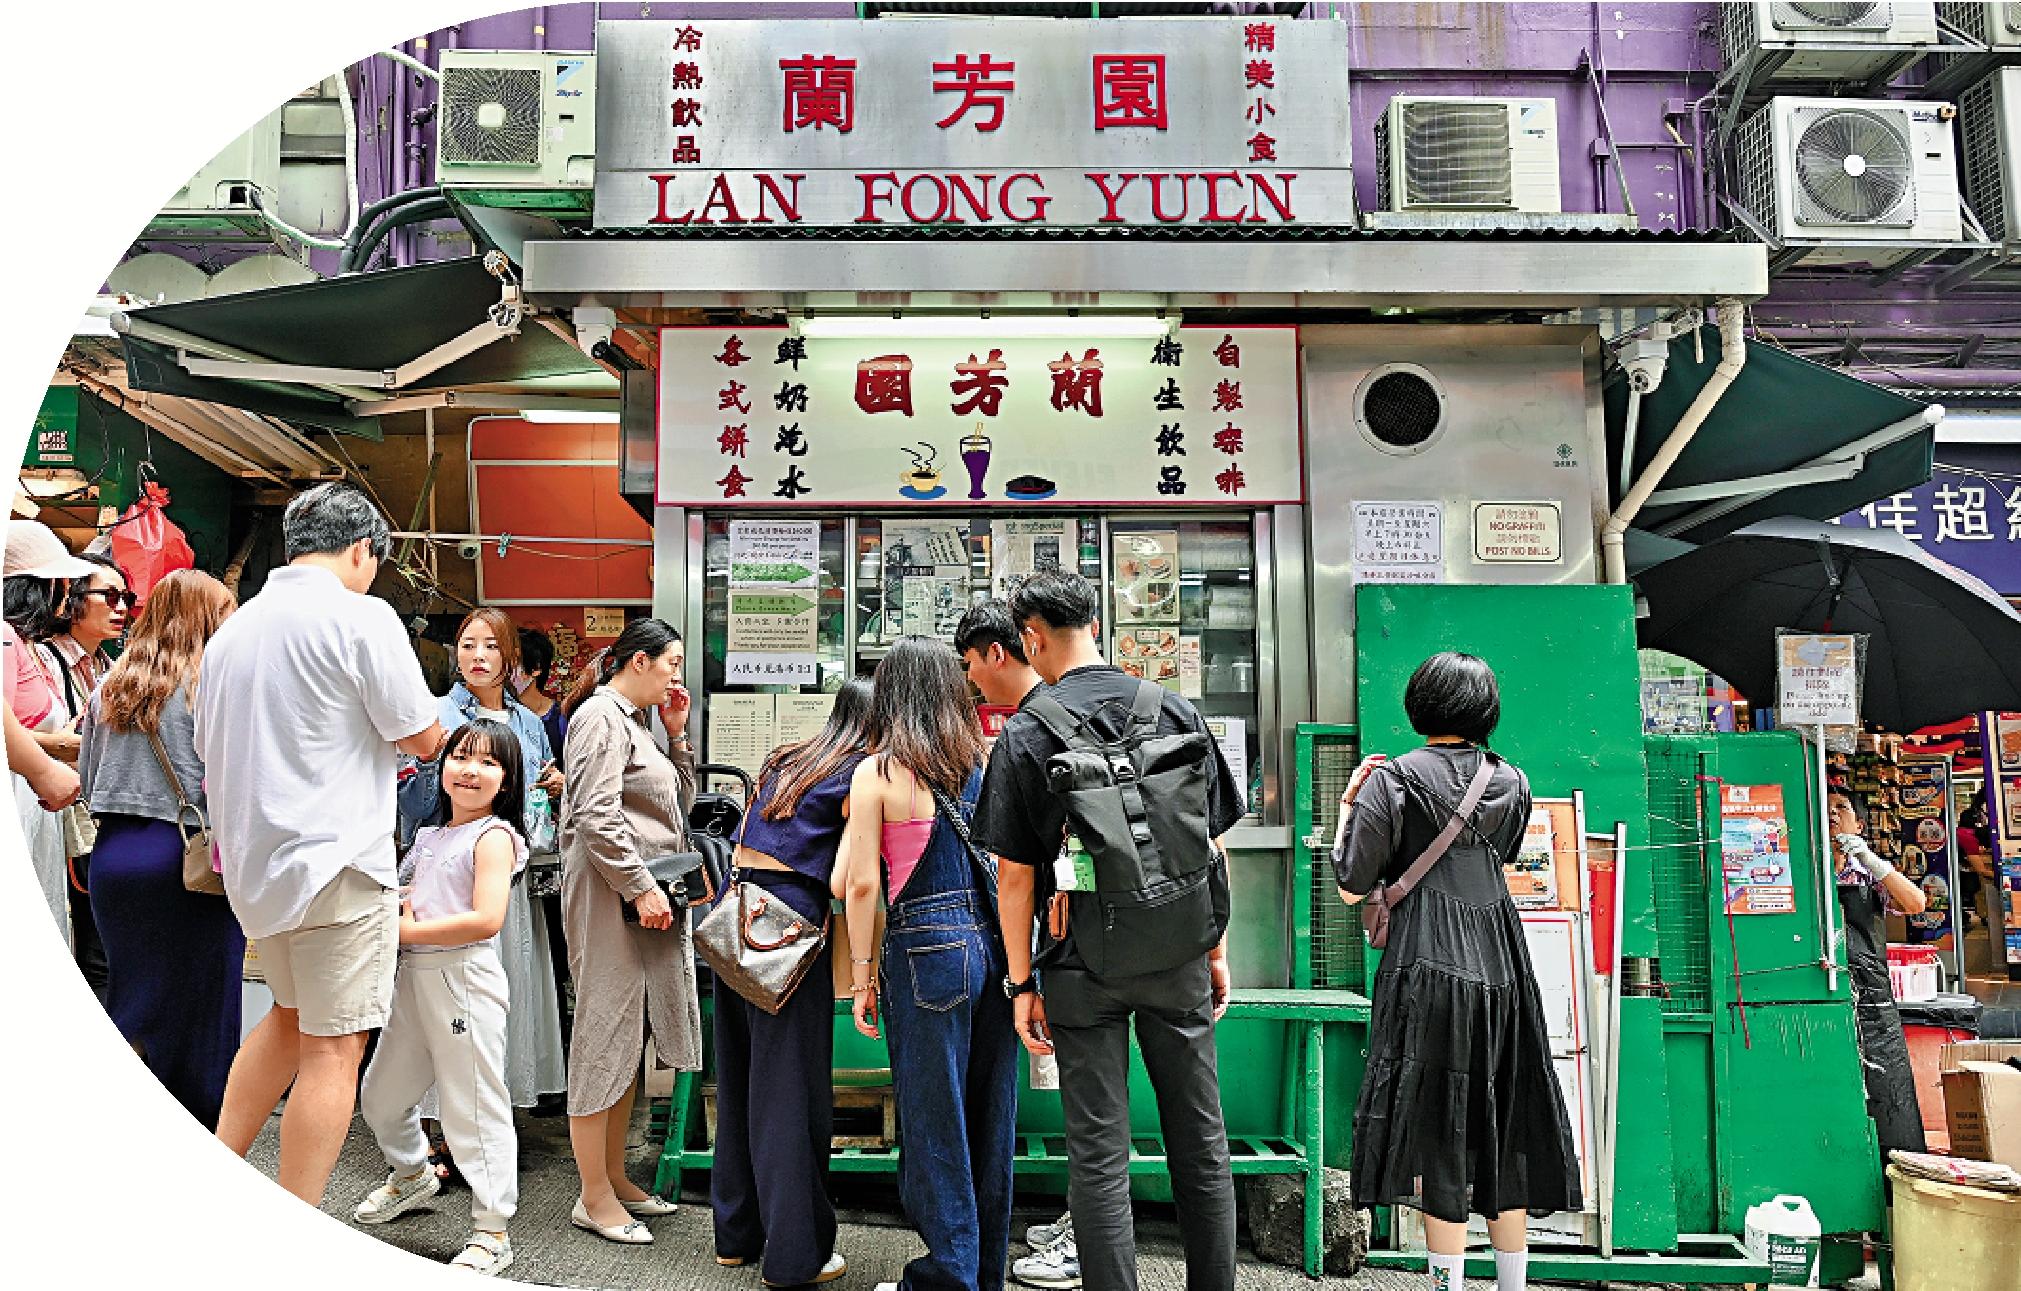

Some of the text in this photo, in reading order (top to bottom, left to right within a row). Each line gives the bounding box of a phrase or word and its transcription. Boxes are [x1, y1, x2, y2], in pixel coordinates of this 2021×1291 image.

[671, 24, 703, 164] 冷熱飲品
[779, 53, 1169, 132] 蘭芳園
[1244, 21, 1278, 163] 精美小食
[648, 170, 1299, 226] LAN FONG YUEN
[1485, 546, 1509, 556] POST
[1510, 546, 1526, 556] NO
[1489, 521, 1546, 531] NO GRAFFITI
